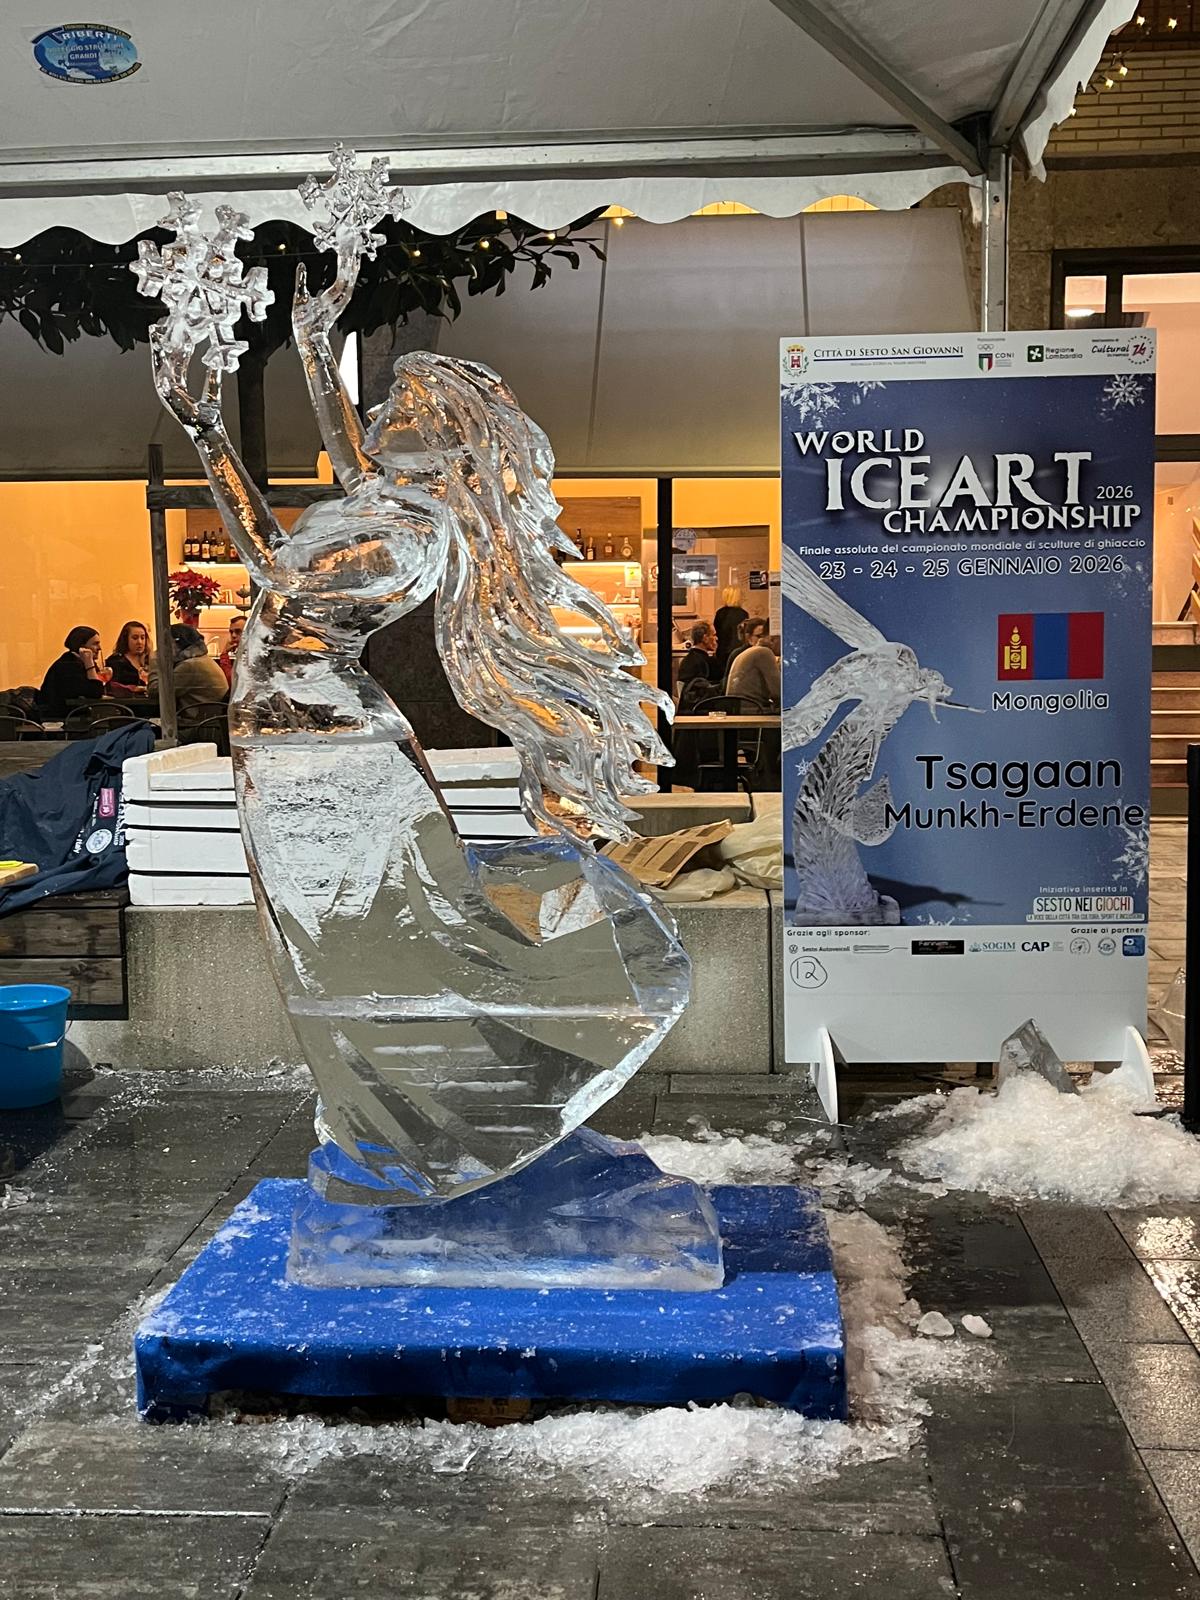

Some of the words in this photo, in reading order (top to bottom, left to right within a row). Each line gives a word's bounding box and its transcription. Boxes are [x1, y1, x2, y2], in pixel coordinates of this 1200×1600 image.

[913, 346, 963, 355] GIOVANNI
[1045, 347, 1075, 355] Regione
[1091, 344, 1130, 353] Cultural
[794, 429, 924, 455] WORLD
[1096, 485, 1134, 500] 2026
[884, 504, 1141, 533] CHAMPIONSHIP
[800, 546, 831, 555] Finale
[835, 545, 878, 554] assoluta
[881, 544, 898, 553] del
[902, 542, 967, 555] campionato
[971, 541, 1021, 550] mondiale
[1025, 540, 1035, 549] di
[1038, 539, 1081, 549] sculture
[1084, 538, 1094, 548] di
[1098, 538, 1145, 550] ghiaccio
[820, 561, 846, 580] 23
[871, 560, 898, 578] 24
[923, 558, 949, 577] 25
[957, 556, 1062, 576] GENNAIO
[1069, 554, 1124, 574] 2026
[992, 690, 1109, 714] Mongolia
[915, 755, 1122, 798] Tsagaan
[885, 799, 1145, 829] Munkh-Erdene
[1036, 897, 1072, 911] SESTO
[1075, 897, 1092, 911] NEI
[1096, 897, 1131, 911] GIOCHI
[816, 929, 832, 937] agli
[982, 942, 1016, 950] SOGIM
[1021, 941, 1050, 952] CAP
[796, 960, 819, 981] 12
